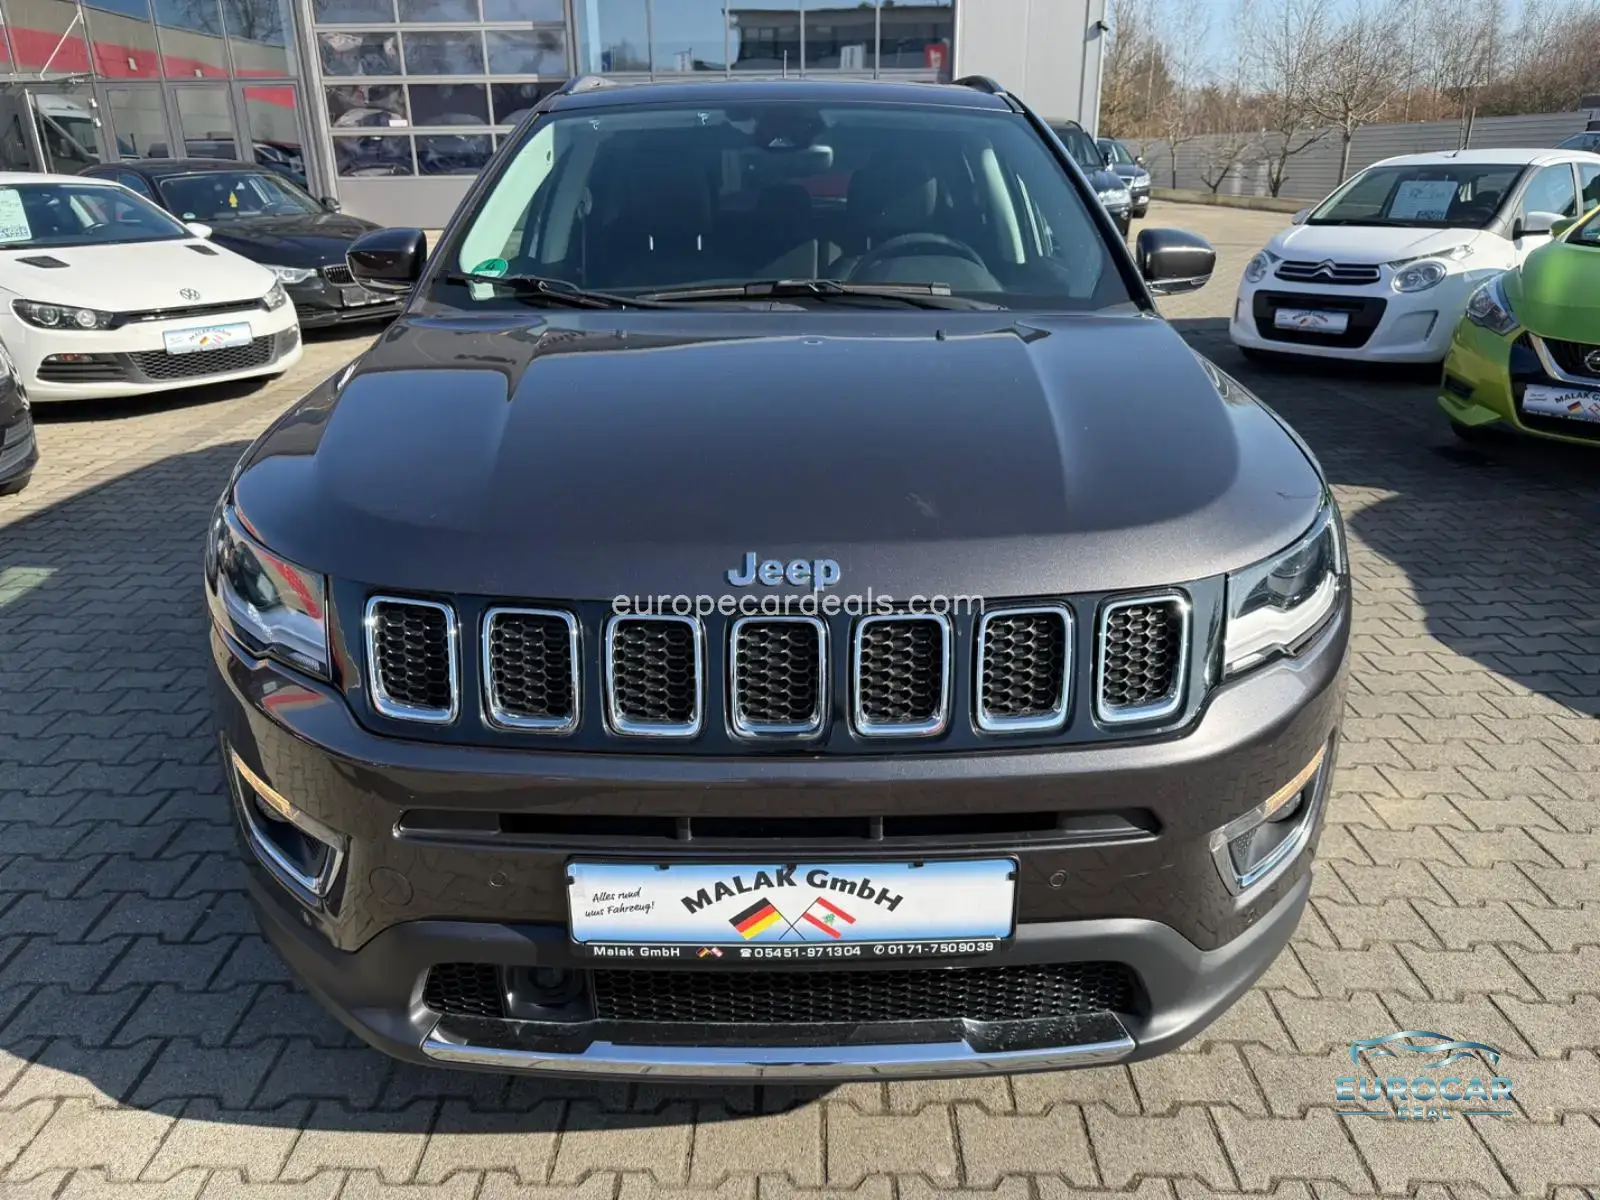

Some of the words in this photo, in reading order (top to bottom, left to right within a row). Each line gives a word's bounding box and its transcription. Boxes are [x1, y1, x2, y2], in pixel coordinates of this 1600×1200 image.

[1555, 391, 1590, 404] MALAK
[726, 551, 841, 592] Jeep
[592, 891, 616, 903] Alles
[618, 886, 642, 900] rund
[681, 867, 798, 914] MALAK
[806, 868, 904, 912] GmbH
[607, 901, 655, 915] Fahrzeug!
[593, 946, 635, 957] Malak
[639, 947, 681, 957] GmbH
[754, 945, 861, 958] 05451-971304
[887, 942, 994, 955] 0171-7509039
